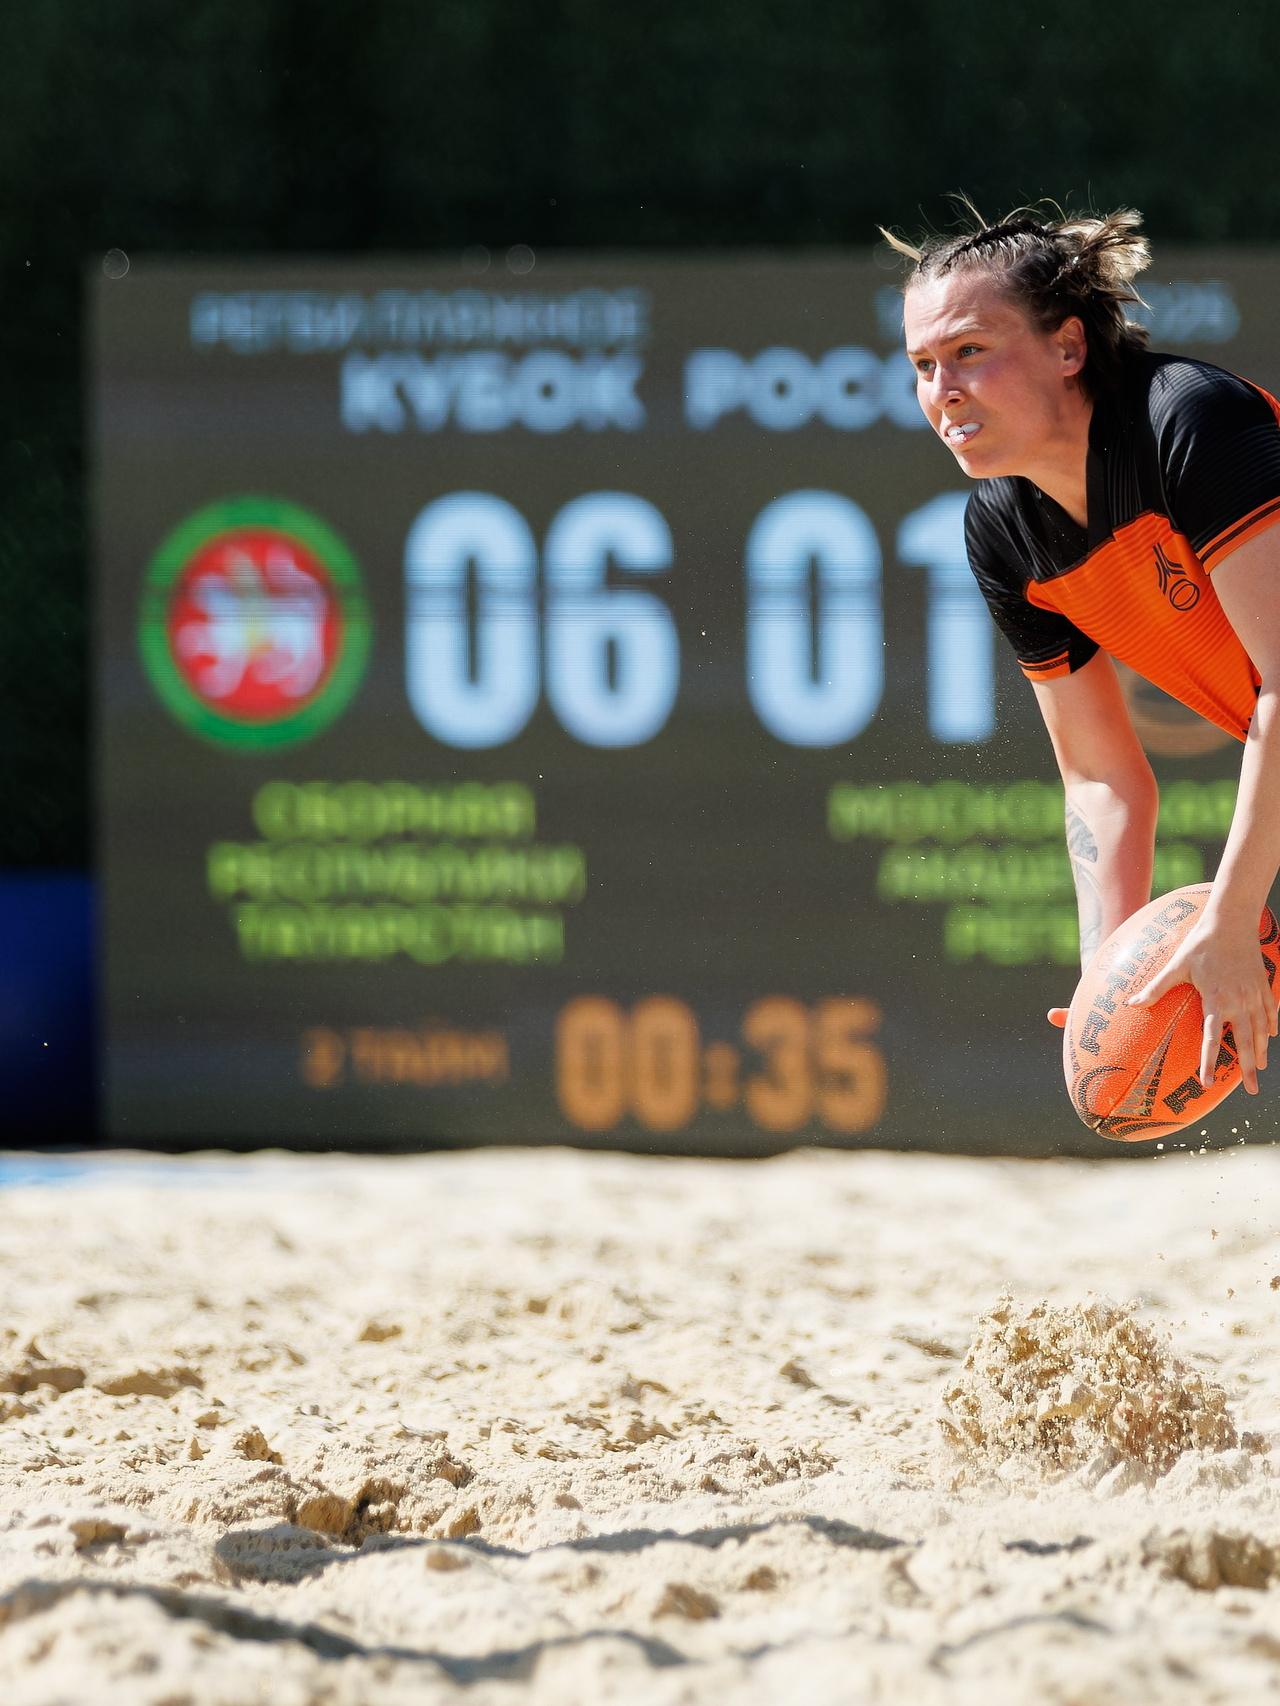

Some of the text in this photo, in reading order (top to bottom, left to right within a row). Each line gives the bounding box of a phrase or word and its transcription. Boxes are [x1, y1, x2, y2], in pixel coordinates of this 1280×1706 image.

[191, 287, 651, 352] РЕГБИ ПЛЯЖНОЕ
[341, 347, 934, 433] КУБОК РОСС
[403, 489, 681, 750] 06
[252, 780, 537, 841] СБОРНАЯ
[207, 842, 587, 902] РЕСПУБЛИКИ
[236, 903, 566, 964] ТАТАРСТАН
[1079, 898, 1197, 1056] RHINO
[305, 1026, 346, 1087] 2
[556, 996, 888, 1132] 00:35
